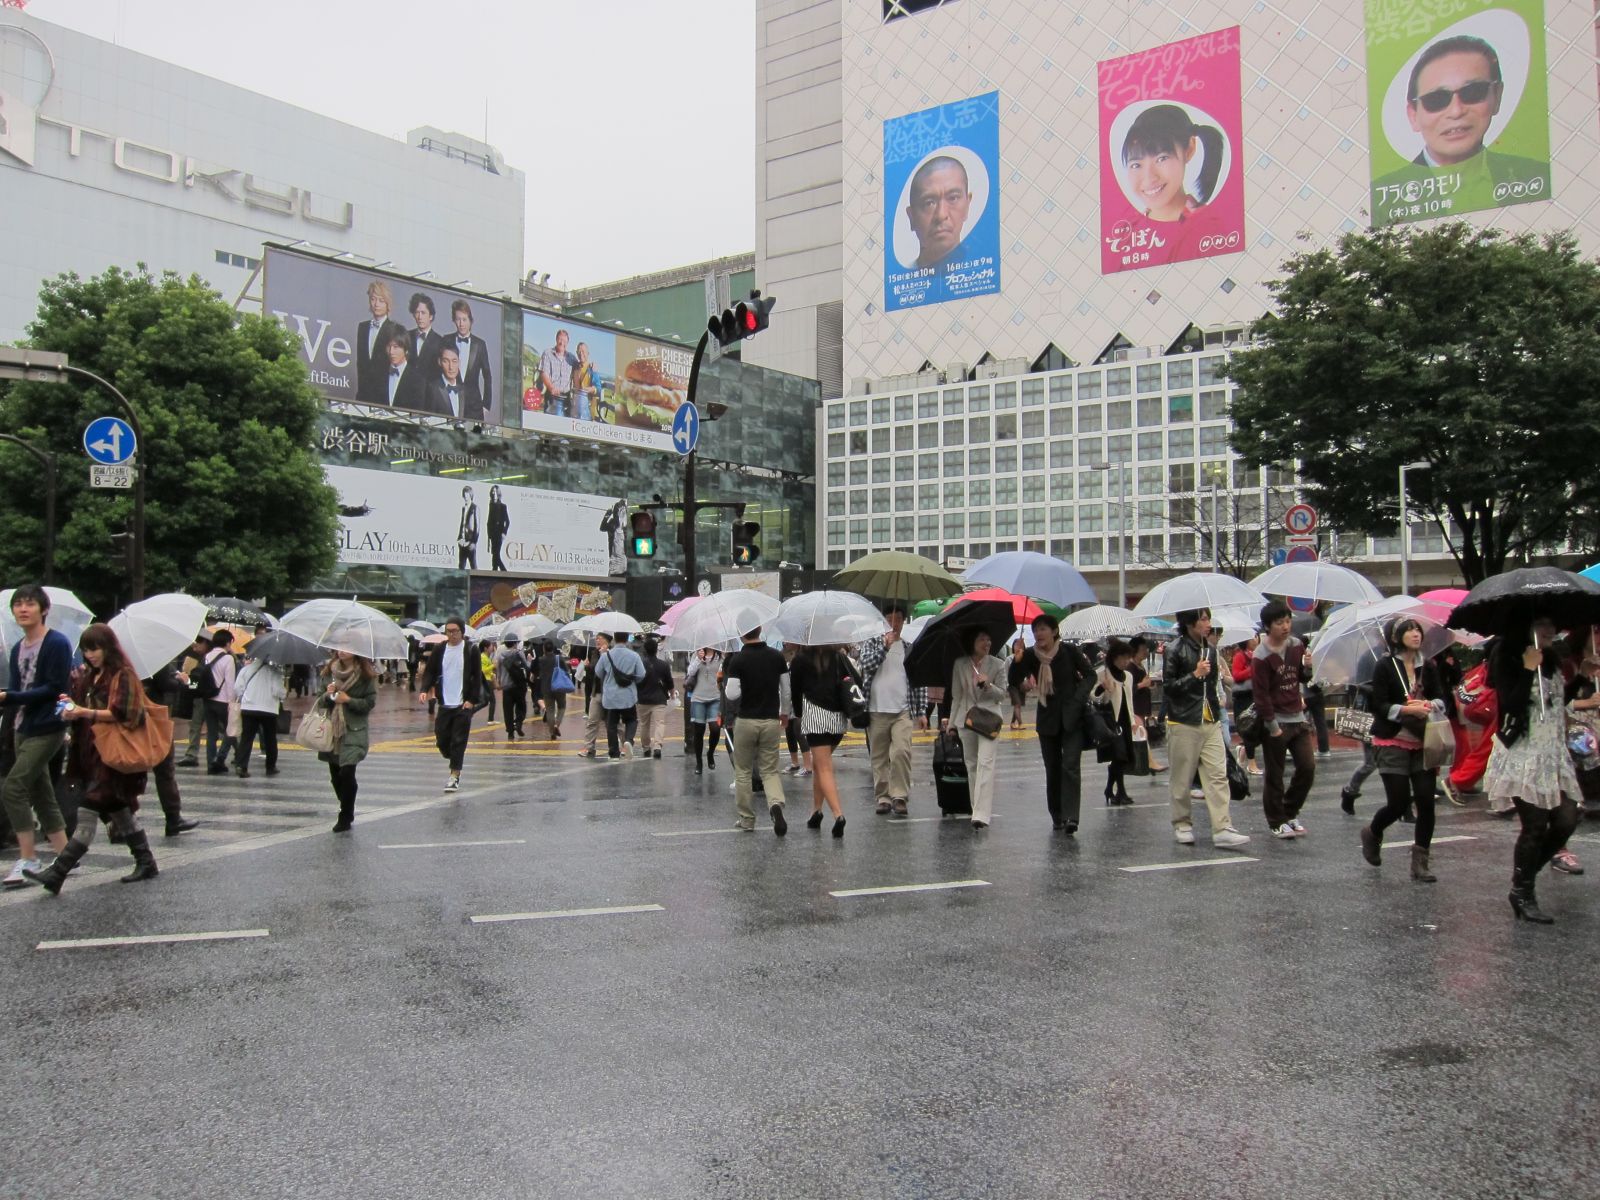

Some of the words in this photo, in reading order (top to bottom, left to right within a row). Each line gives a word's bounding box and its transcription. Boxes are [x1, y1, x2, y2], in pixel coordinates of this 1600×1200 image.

[39, 113, 353, 229] TOKYU
[1493, 178, 1543, 200] NHK
[1200, 232, 1239, 251] NHK
[322, 426, 389, 456] 渋谷駅
[394, 445, 444, 463] shibuya
[447, 454, 488, 468] station
[389, 540, 411, 554] 10th
[412, 543, 455, 556] ALBUM
[505, 541, 554, 562] GLAY
[554, 551, 573, 563] 10.13
[574, 554, 605, 566] Release
